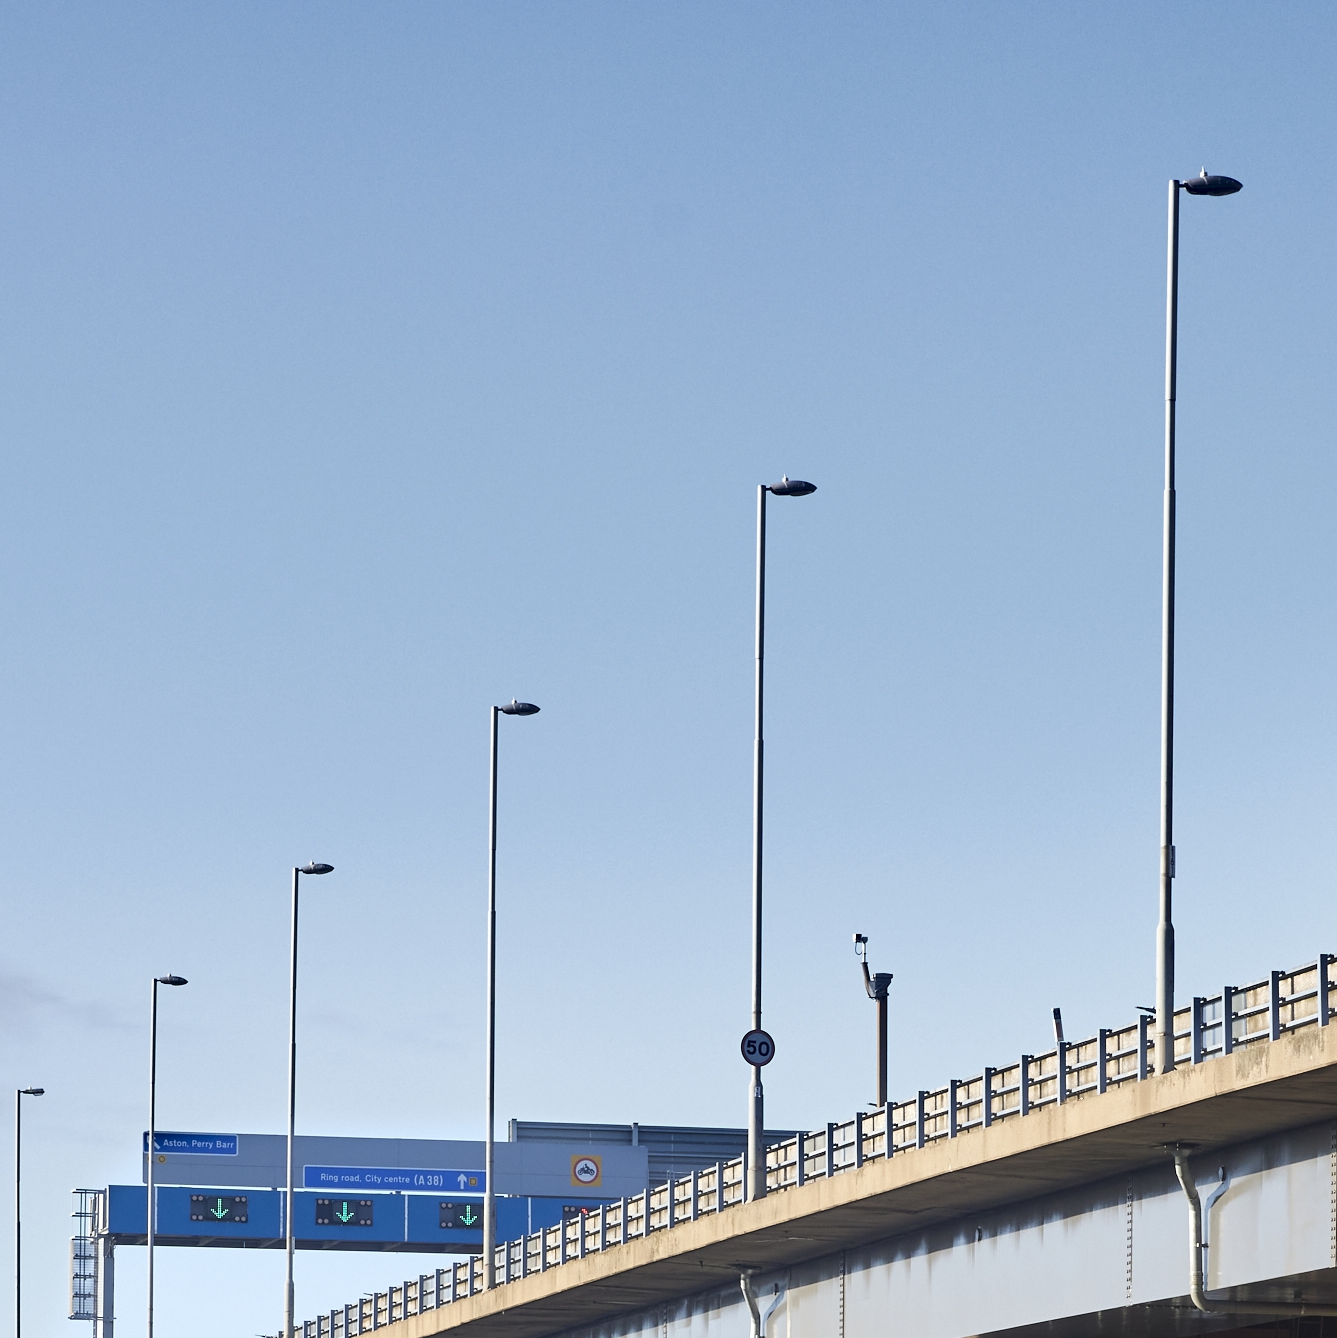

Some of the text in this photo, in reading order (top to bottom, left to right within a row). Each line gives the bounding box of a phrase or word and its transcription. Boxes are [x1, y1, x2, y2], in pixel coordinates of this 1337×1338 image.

[746, 1039, 770, 1057] 50
[191, 1140, 213, 1149] Perry
[216, 1140, 234, 1149] Barr
[320, 1173, 338, 1182] Ring
[365, 1174, 382, 1184] City
[384, 1175, 410, 1184] centre
